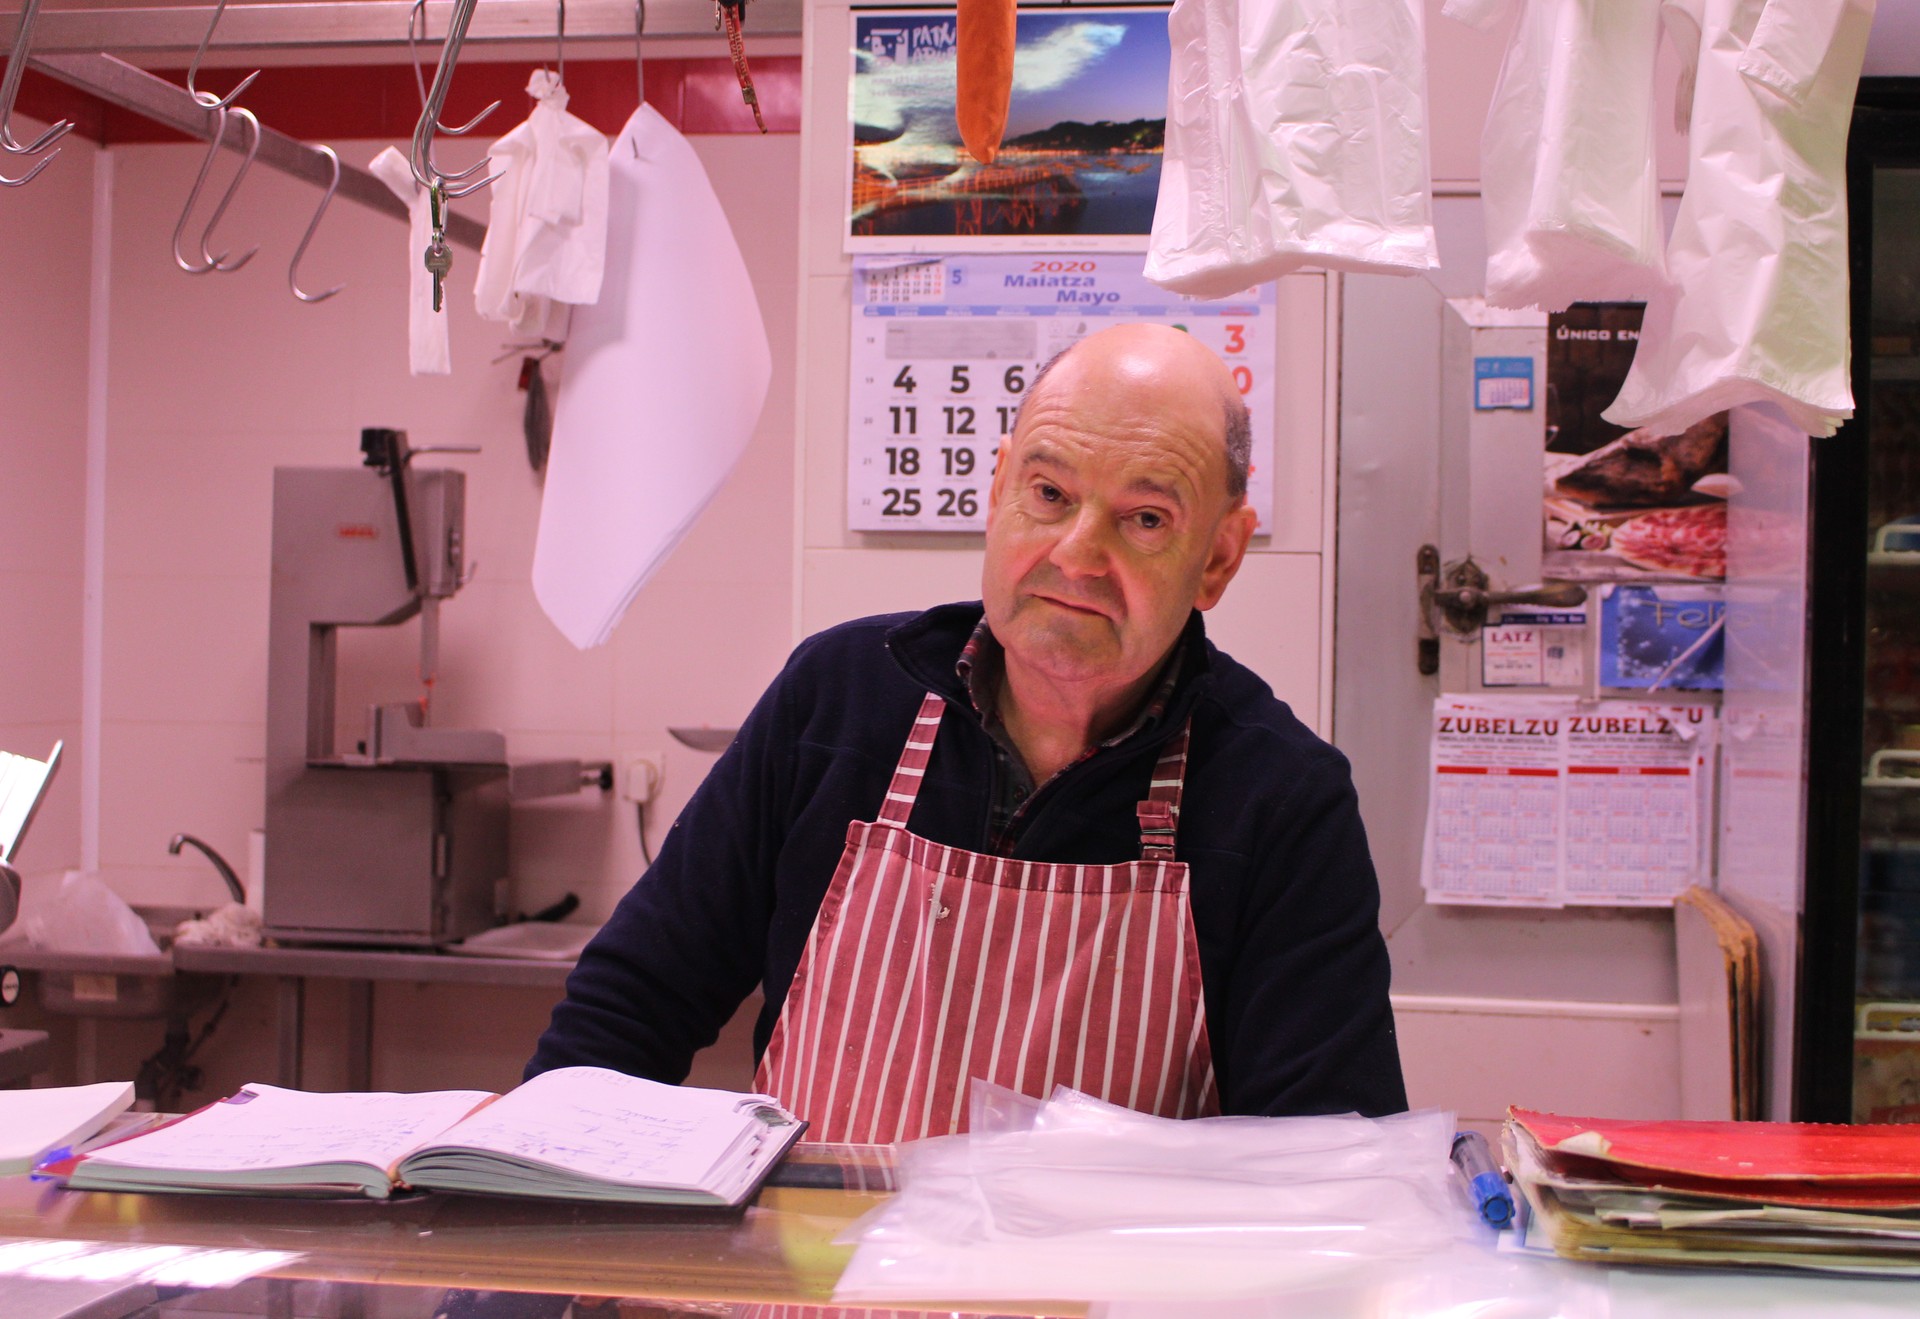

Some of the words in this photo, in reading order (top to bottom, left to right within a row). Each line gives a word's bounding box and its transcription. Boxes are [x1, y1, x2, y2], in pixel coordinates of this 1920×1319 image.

[1030, 261, 1097, 273] 2020
[952, 269, 962, 284] 5
[1004, 275, 1096, 287] Maiatza
[1056, 290, 1120, 306] Mayo
[1225, 324, 1245, 353] 3
[1556, 324, 1611, 340] ÚNICO
[1617, 329, 1640, 340] EN
[893, 365, 917, 393] 4
[950, 366, 970, 394] 5
[1004, 365, 1025, 394] 6
[1232, 366, 1253, 395] 0
[889, 406, 917, 434] 11
[942, 406, 976, 434] 12
[885, 447, 920, 475] 18
[941, 447, 975, 476] 19
[882, 488, 921, 516] 25
[937, 488, 978, 517] 26
[1491, 632, 1532, 642] LATZ
[1438, 717, 1559, 736] ZUBELZU
[1568, 716, 1673, 734] ZUBELZ
